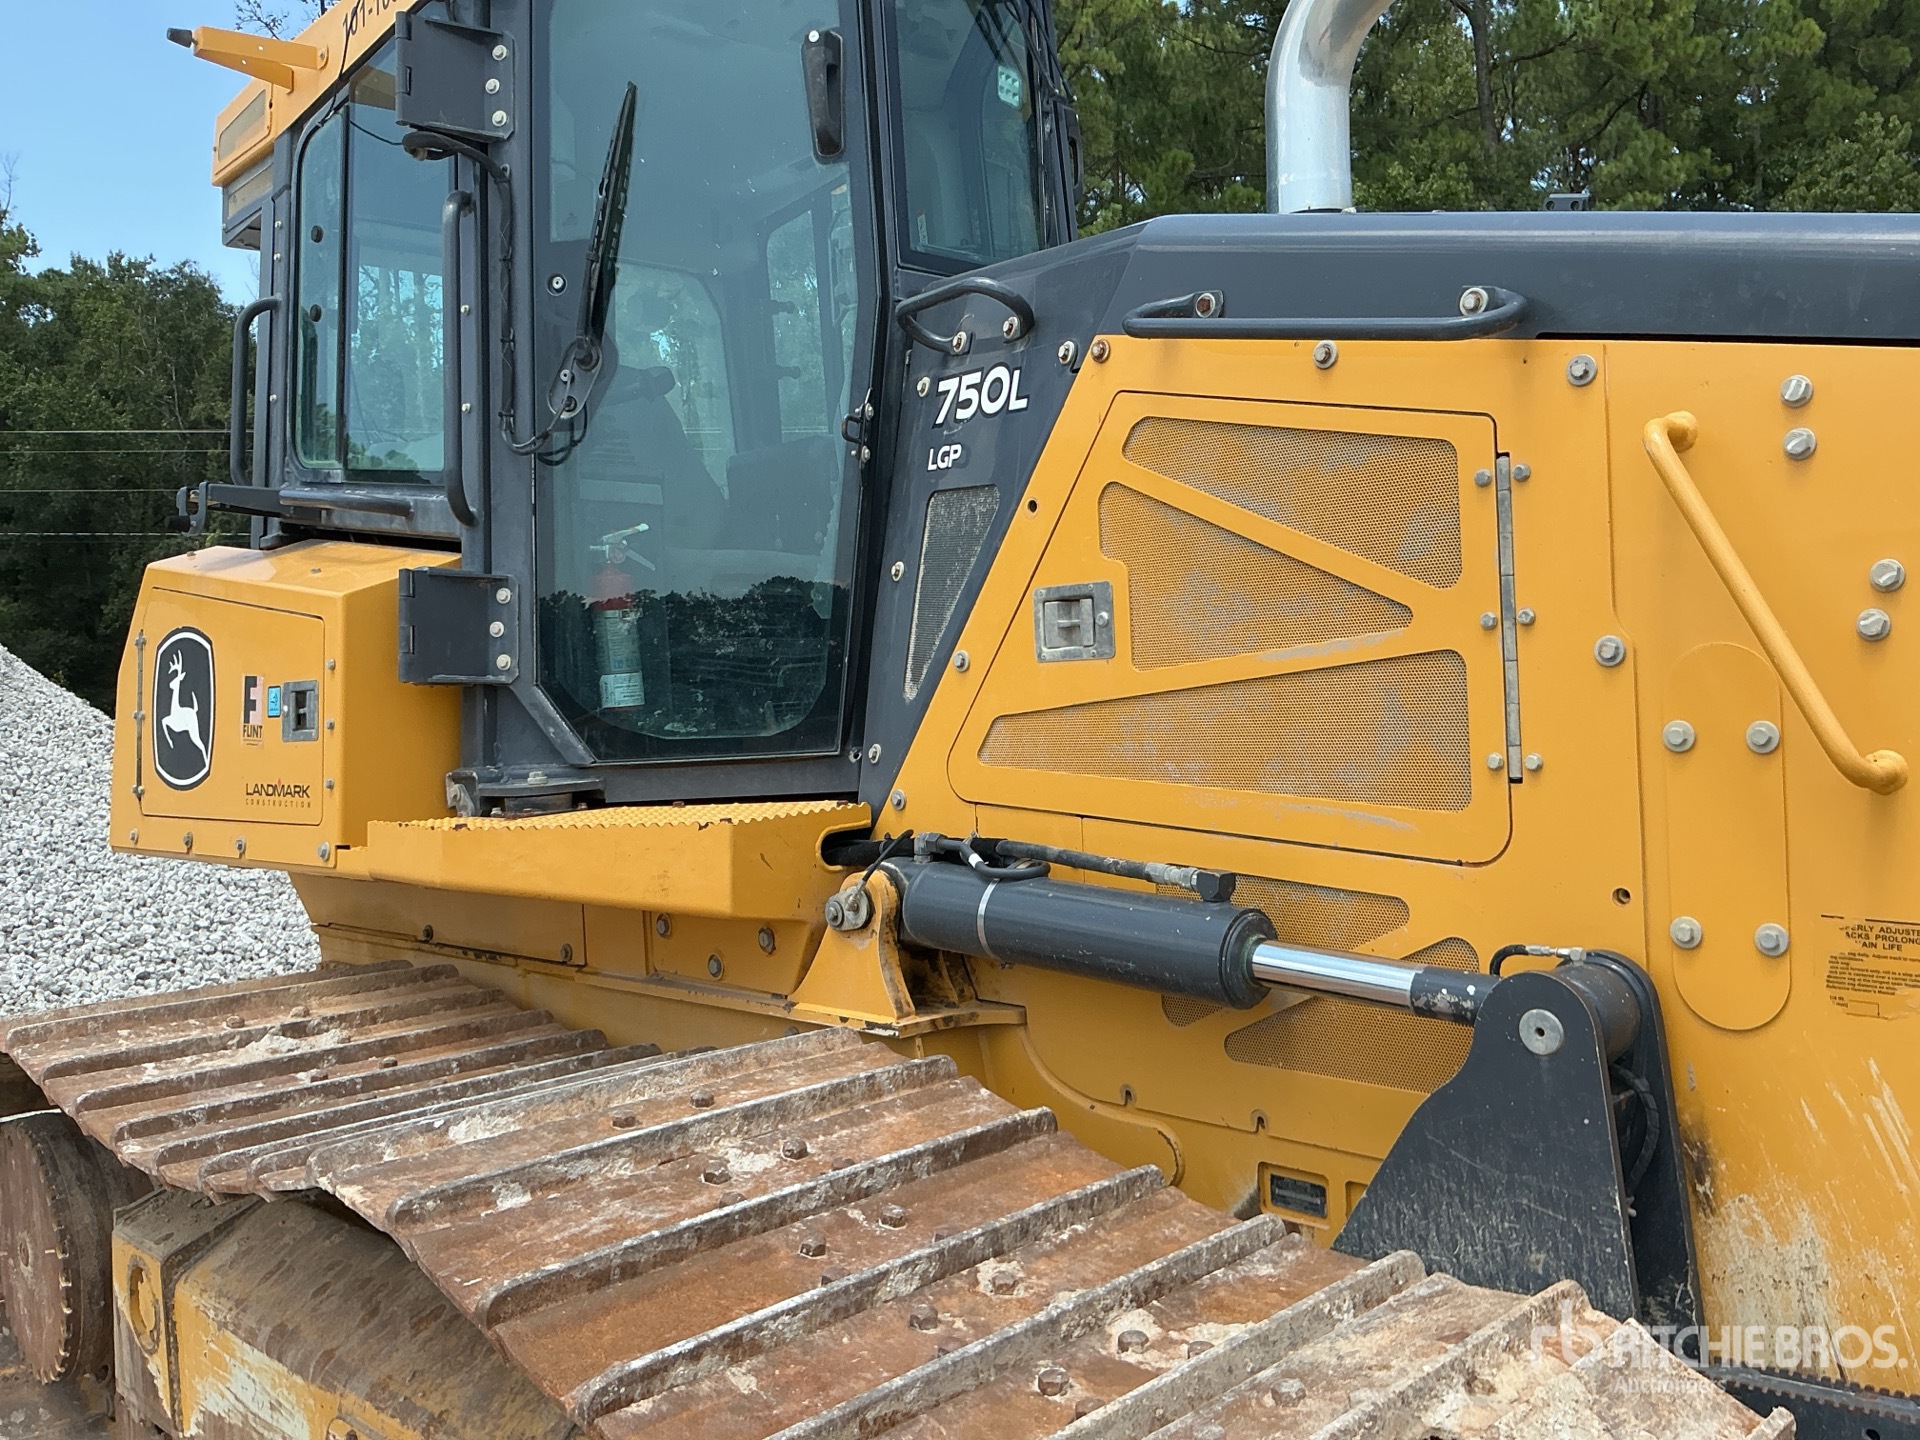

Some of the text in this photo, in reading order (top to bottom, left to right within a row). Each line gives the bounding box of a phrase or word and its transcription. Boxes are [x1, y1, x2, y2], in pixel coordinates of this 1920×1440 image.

[934, 364, 1029, 425] 750L
[927, 443, 963, 471] LGP
[243, 725, 263, 738] FLINT
[245, 783, 311, 798] LANDMARK
[245, 798, 312, 808] CONSTRUCTION
[1883, 943, 1903, 951] LIFE
